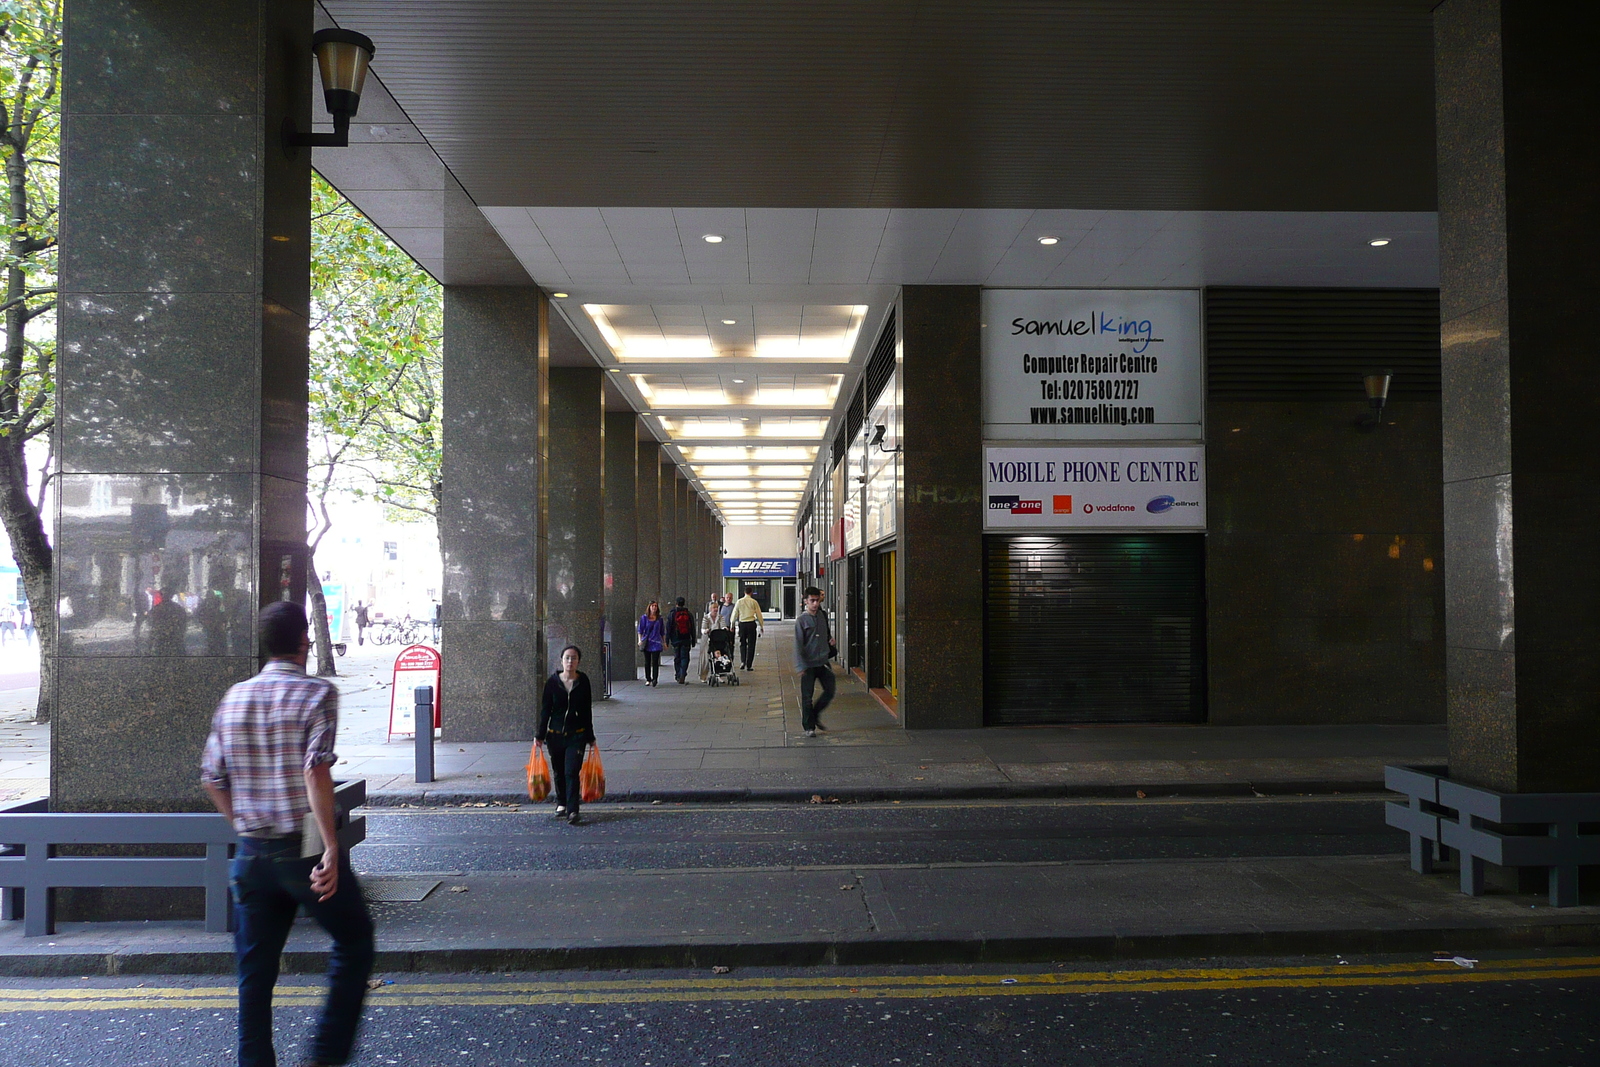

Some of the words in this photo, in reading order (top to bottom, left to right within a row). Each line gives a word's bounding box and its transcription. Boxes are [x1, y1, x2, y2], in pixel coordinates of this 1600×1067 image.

[1023, 353, 1079, 375] Computer
[1080, 353, 1118, 375] Repair
[1119, 353, 1158, 374] Centre
[1030, 403, 1155, 426] www.samuelking.com
[988, 461, 1057, 483] MOBILE
[1062, 461, 1121, 483] PHONE
[1126, 461, 1199, 483] CENTRE
[1096, 504, 1136, 512] vodafone
[730, 561, 789, 570] BOSE
